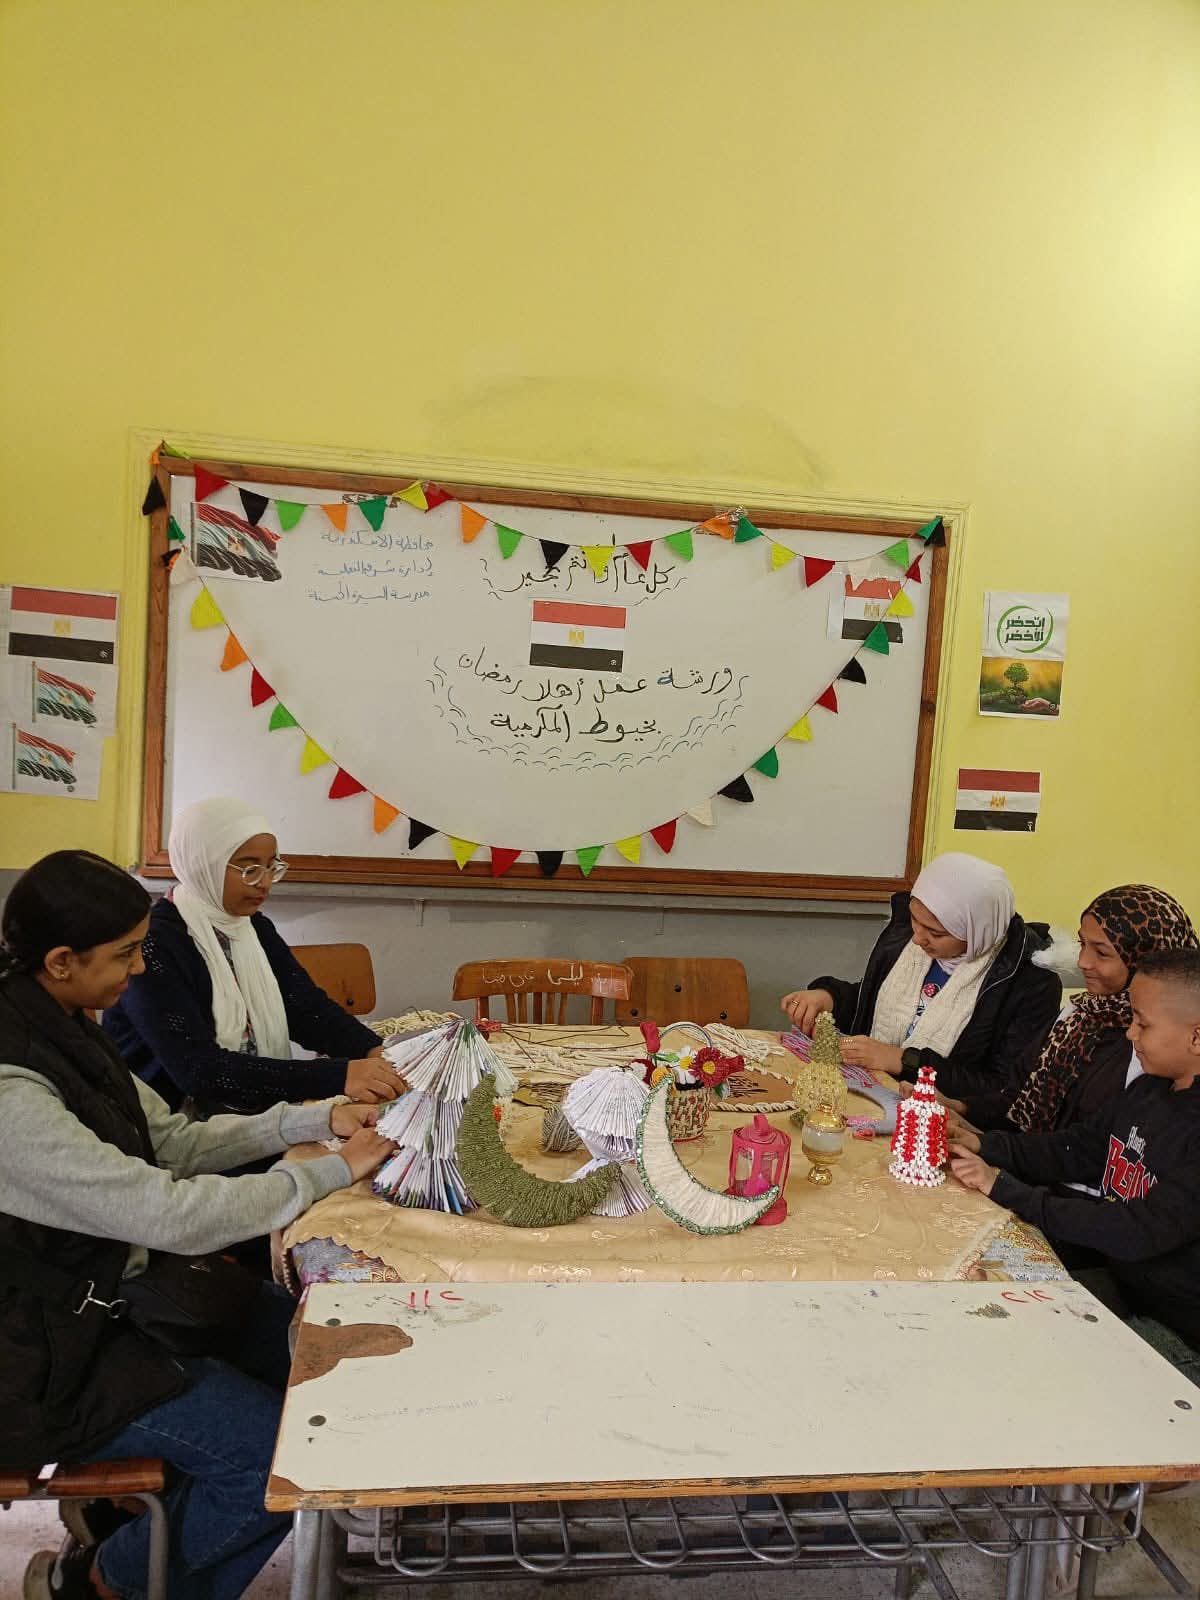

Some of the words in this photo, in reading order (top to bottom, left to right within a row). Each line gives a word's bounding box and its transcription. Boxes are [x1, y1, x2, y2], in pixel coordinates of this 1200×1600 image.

[646, 562, 676, 593] كل
[391, 590, 430, 603] مدرسة
[1004, 629, 1044, 644] للأخضر
[458, 645, 523, 695] رمضان
[656, 667, 733, 695] ورشة
[594, 679, 648, 703] عمل
[578, 705, 662, 743] بخيوط
